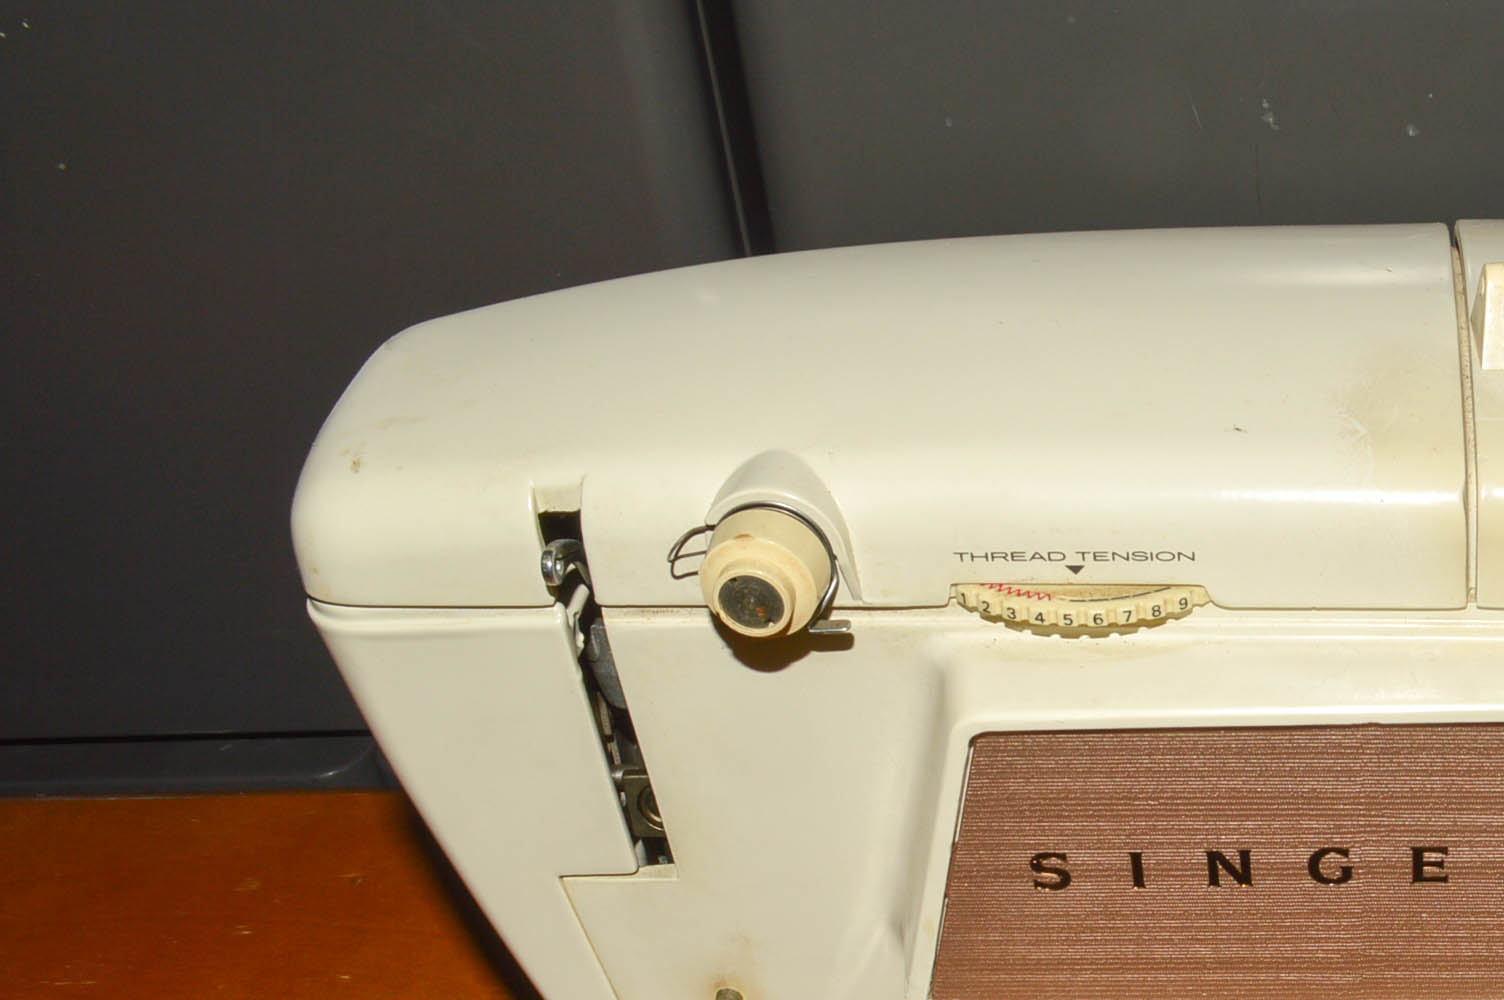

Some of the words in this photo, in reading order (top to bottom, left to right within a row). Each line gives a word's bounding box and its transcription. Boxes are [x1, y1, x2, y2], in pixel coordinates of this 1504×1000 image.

[953, 551, 1067, 562] THREAD
[1076, 551, 1196, 562] TENSION
[982, 601, 991, 614] 2
[1006, 607, 1016, 620] 3
[1034, 612, 1046, 624] 4
[1063, 614, 1073, 626] 5
[1093, 614, 1104, 625] 6
[1122, 610, 1133, 623] 7
[1151, 605, 1161, 618] 8
[1178, 598, 1188, 611] 9
